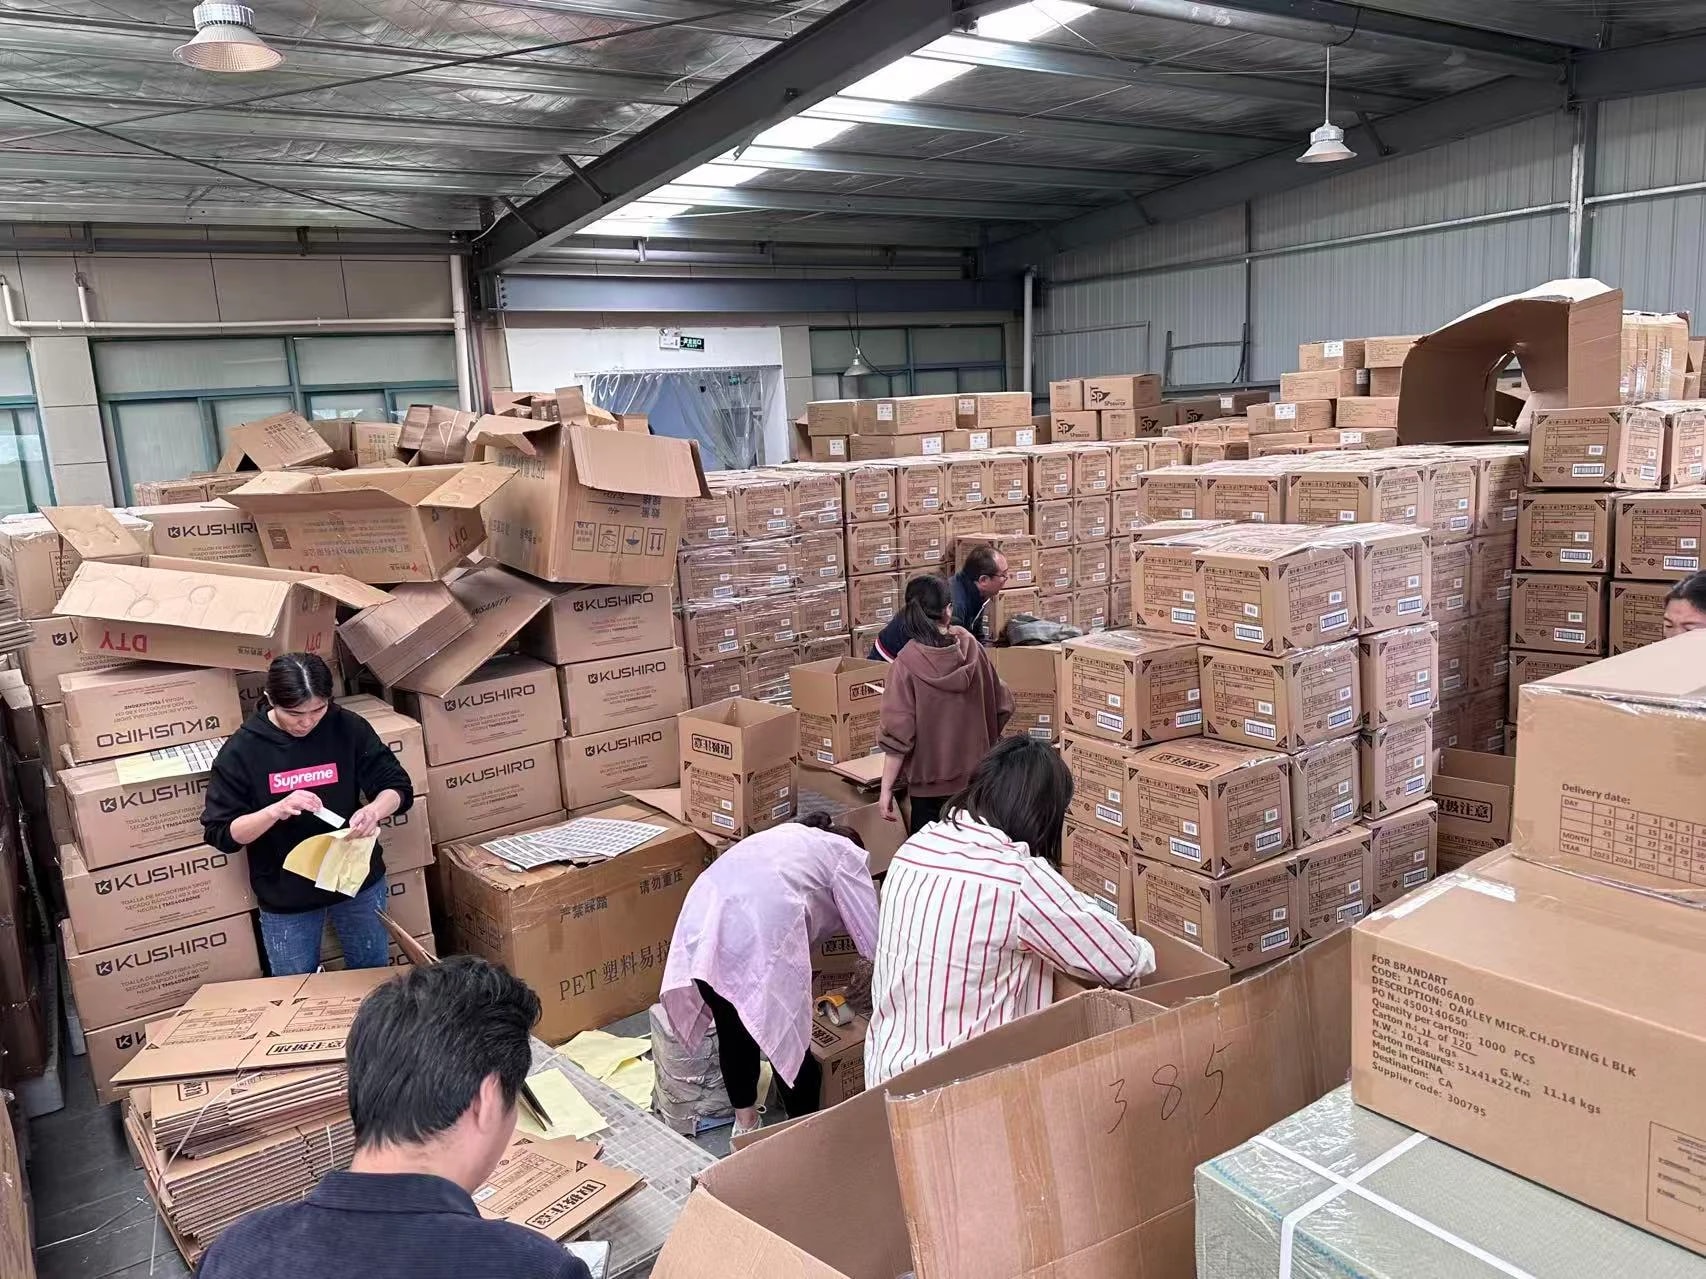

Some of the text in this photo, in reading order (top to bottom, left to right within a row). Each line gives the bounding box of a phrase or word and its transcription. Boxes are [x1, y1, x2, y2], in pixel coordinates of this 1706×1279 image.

[585, 592, 654, 611] KUSHIRO
[99, 631, 147, 653] DTY
[600, 661, 666, 682] KUSHIRO
[458, 684, 536, 709] KUSHIRO
[97, 719, 204, 748] KUSHIRO
[597, 731, 662, 755] KUSHIRO
[273, 768, 334, 789] Supreme
[459, 758, 535, 787] KUSHIRO
[119, 777, 210, 809] KUSHIR
[1561, 783, 1631, 805] Delivery date:
[1564, 799, 1579, 808] DAY
[1562, 831, 1590, 844] MONTH
[1603, 818, 1612, 827] 13
[1625, 823, 1634, 831] 14
[1664, 832, 1674, 840] 16
[1680, 836, 1690, 844] 17
[1647, 840, 1656, 848] 27
[1663, 844, 1673, 852] 28
[1561, 842, 1656, 871] YEAR 2023 2024 2025
[115, 854, 228, 891] KUSHIRO
[640, 869, 683, 894] 请勿重压
[560, 895, 608, 923] 严禁踩踏
[115, 932, 227, 972] KUSHIRO
[1371, 954, 1448, 985] FOR BRANDART
[559, 969, 597, 1002] PET
[1371, 965, 1474, 1006] CODE: 1AC0606A00
[1372, 986, 1468, 1027] PO N.: 4500140650
[1372, 976, 1637, 1077] DESCRIPTION: OAKLEY MICR.CH.DYEING L BLK
[1372, 1008, 1402, 1025] Carton
[1405, 1021, 1417, 1031] n.:
[1437, 1033, 1449, 1042] of
[1453, 1038, 1472, 1051] 120
[1372, 997, 1536, 1065] Quantity per carton: 1000 PCS
[1372, 1040, 1444, 1075] Made in CHINA
[1372, 1029, 1531, 1099] Carton measures: 51x41x22 cm
[1372, 1018, 1601, 1114] N.W.: 10.14 kgs G.W.: 11.14 kgs
[1372, 1050, 1453, 1089] Destination: CA
[1108, 1042, 1233, 1134] 385
[1372, 1061, 1487, 1117] Supplier code: 300795
[531, 1183, 598, 1226] 取扱注意
